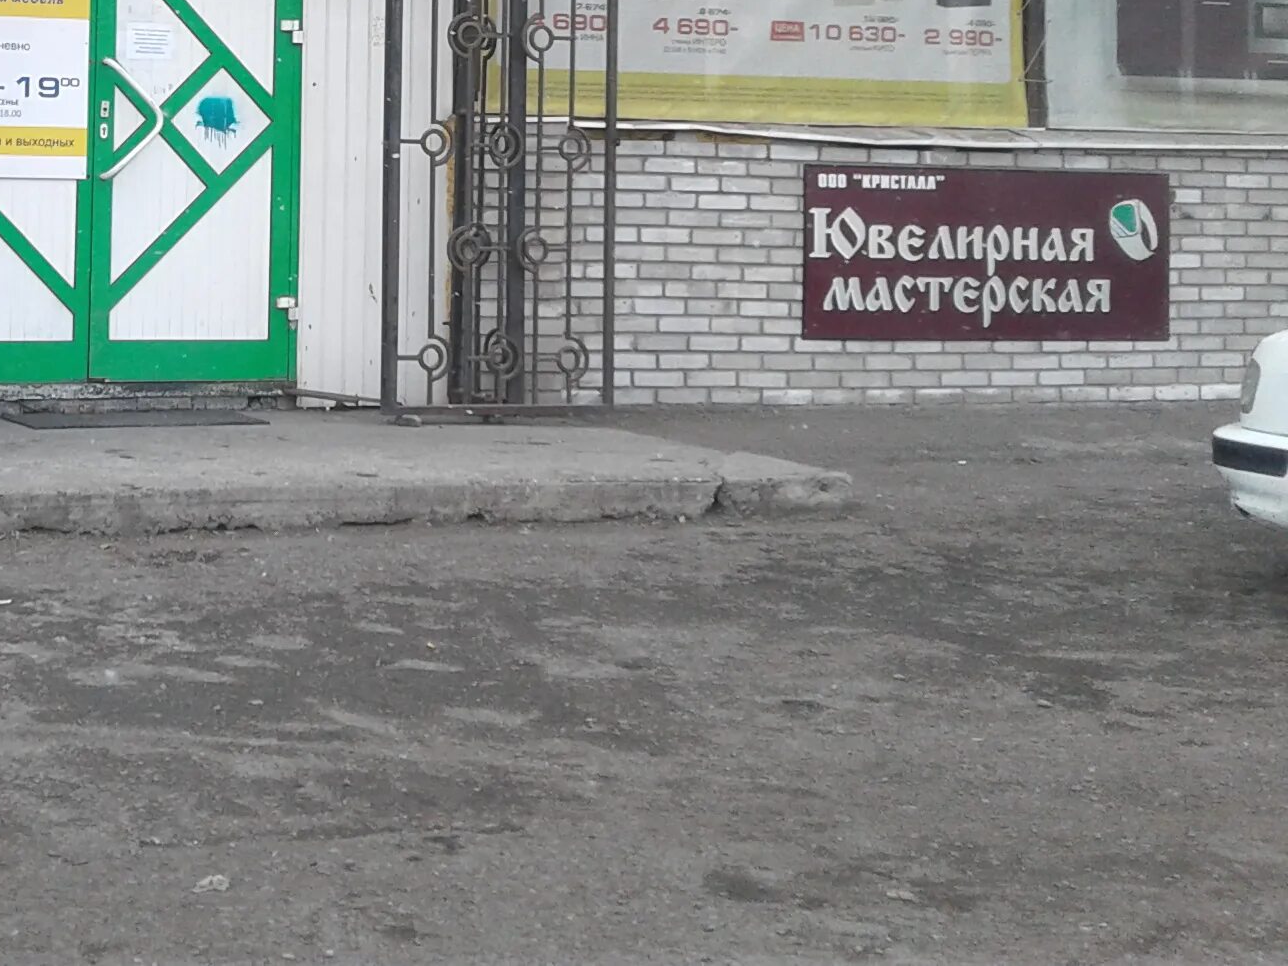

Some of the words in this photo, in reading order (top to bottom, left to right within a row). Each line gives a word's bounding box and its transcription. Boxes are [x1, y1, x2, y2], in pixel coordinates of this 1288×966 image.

[652, 17, 670, 35] 4
[809, 24, 842, 41] 10
[924, 29, 941, 45] 2
[5, 137, 13, 146] и
[16, 138, 75, 149] выходных
[817, 173, 847, 189] ООО
